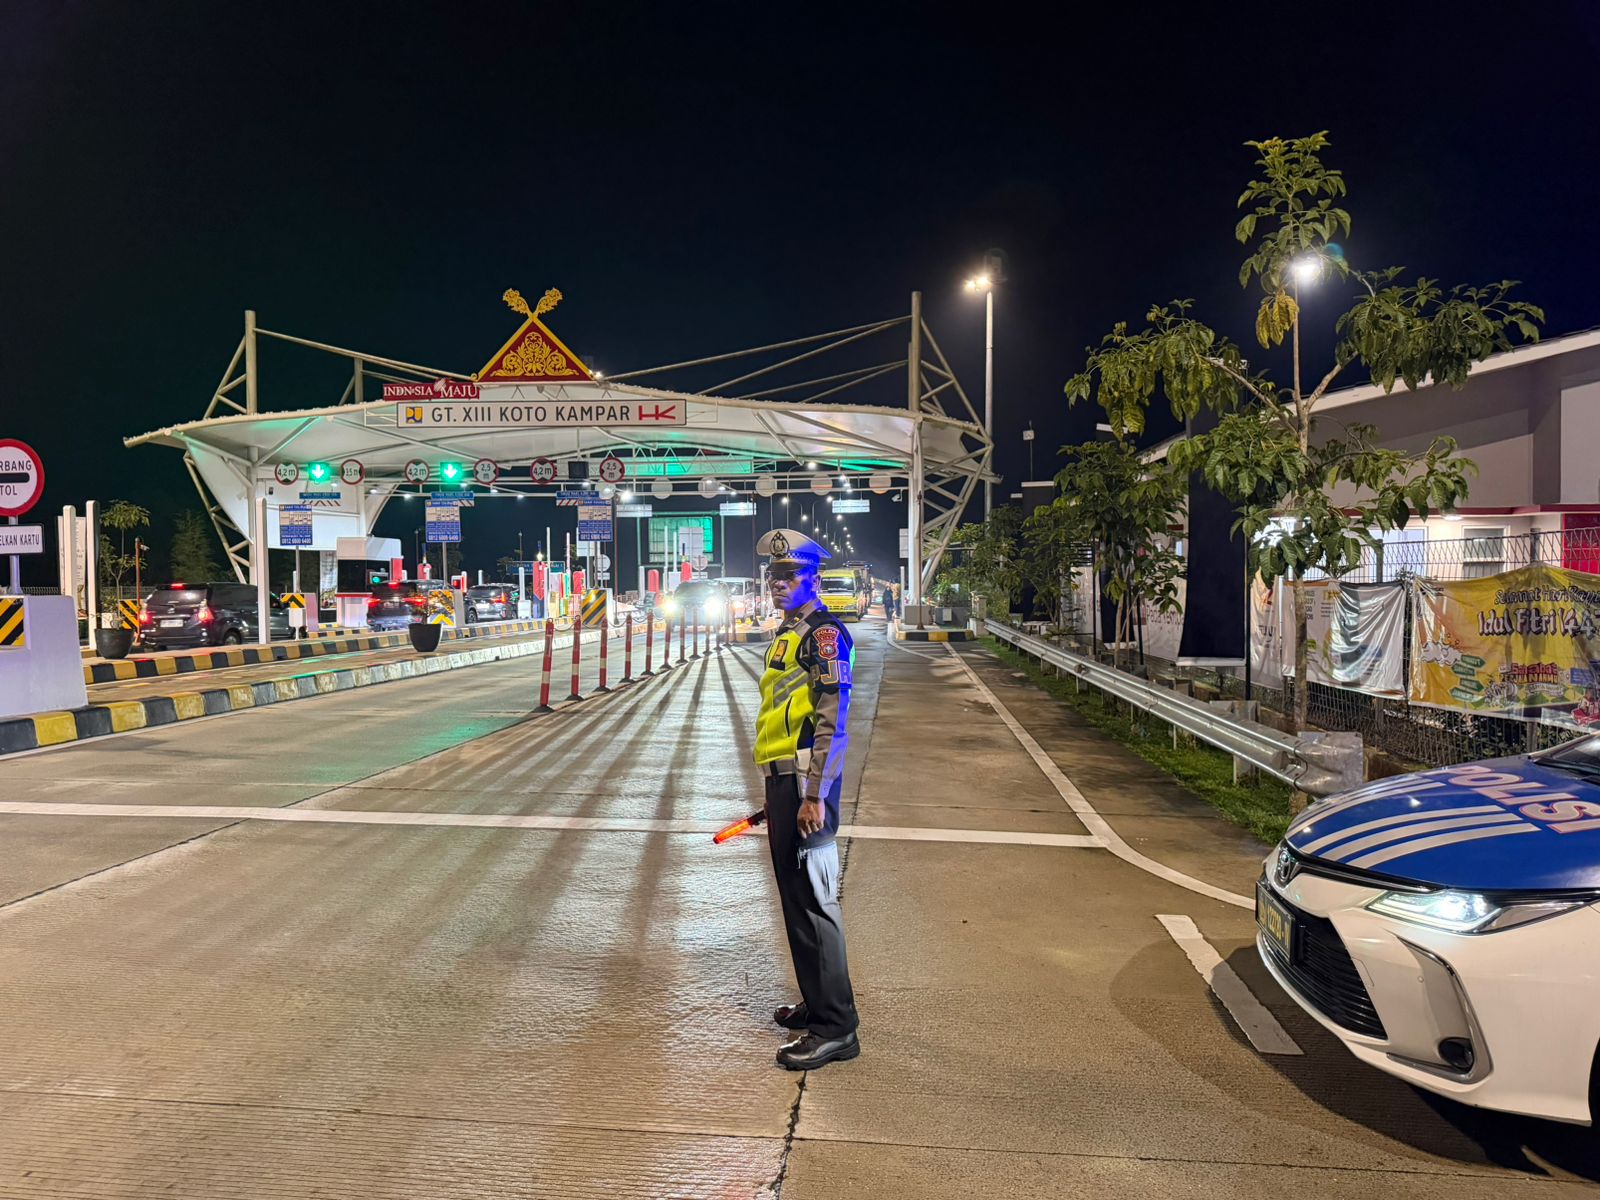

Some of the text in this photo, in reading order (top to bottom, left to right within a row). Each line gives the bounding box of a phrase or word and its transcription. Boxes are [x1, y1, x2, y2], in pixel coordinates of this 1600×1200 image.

[440, 384, 478, 398] MAJU
[431, 406, 457, 423] GT.
[462, 406, 491, 423] XIII
[499, 405, 547, 422] KOTO
[555, 404, 630, 422] KAMPAR
[638, 404, 676, 421] HK
[533, 466, 543, 477] 4,2
[0, 484, 18, 496] TOL
[20, 533, 40, 546] KARTU
[1478, 609, 1513, 637] Idul
[1515, 608, 1557, 636] Fitri
[815, 628, 837, 637] POLDA
[810, 659, 852, 688] PJR
[1433, 765, 1600, 834] POLISI
